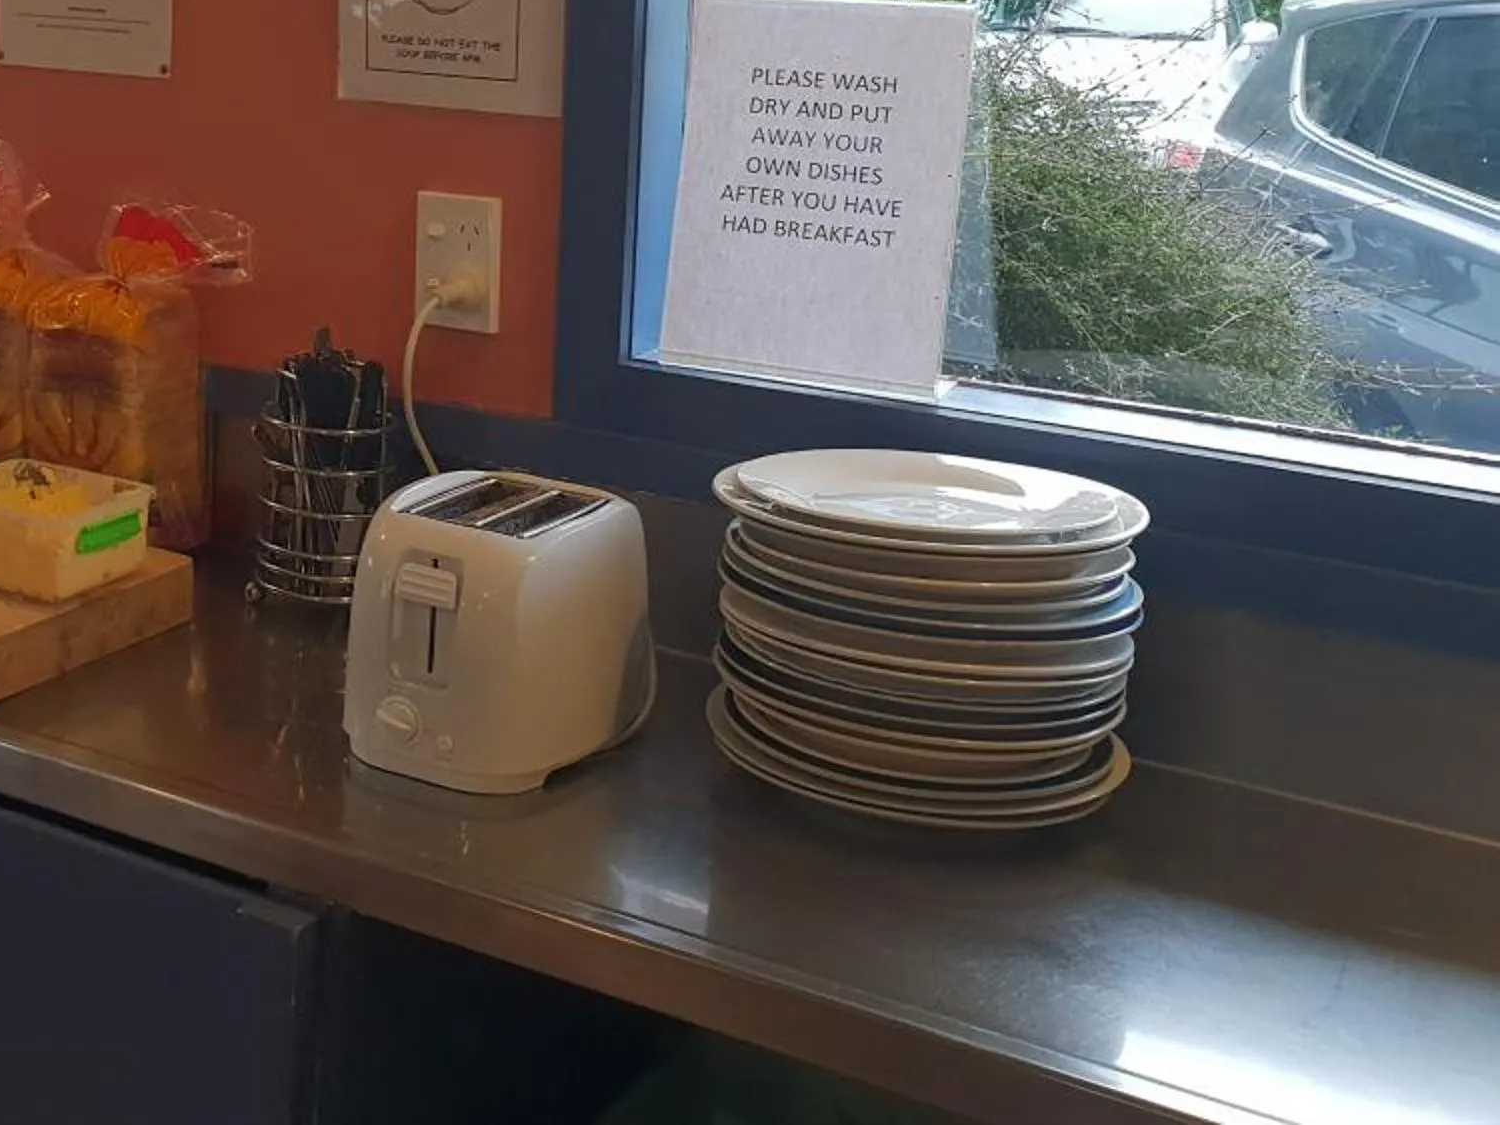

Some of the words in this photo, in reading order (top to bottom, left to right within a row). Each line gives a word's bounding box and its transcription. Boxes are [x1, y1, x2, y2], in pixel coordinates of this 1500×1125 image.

[482, 40, 502, 52] THE
[751, 67, 827, 89] PLEASE
[832, 72, 898, 94] WASH
[749, 96, 792, 116] DRY
[795, 100, 843, 120] AND
[850, 104, 893, 124] PUT
[751, 127, 817, 148] AWAY
[823, 132, 884, 154] YOUR
[745, 156, 801, 177] OWN
[808, 162, 884, 185] DISHES
[720, 184, 785, 206] AFTER
[791, 190, 837, 212] YOU
[843, 194, 903, 218] HAVE
[722, 214, 767, 234] HAD
[774, 219, 897, 248] BREAKFAST
